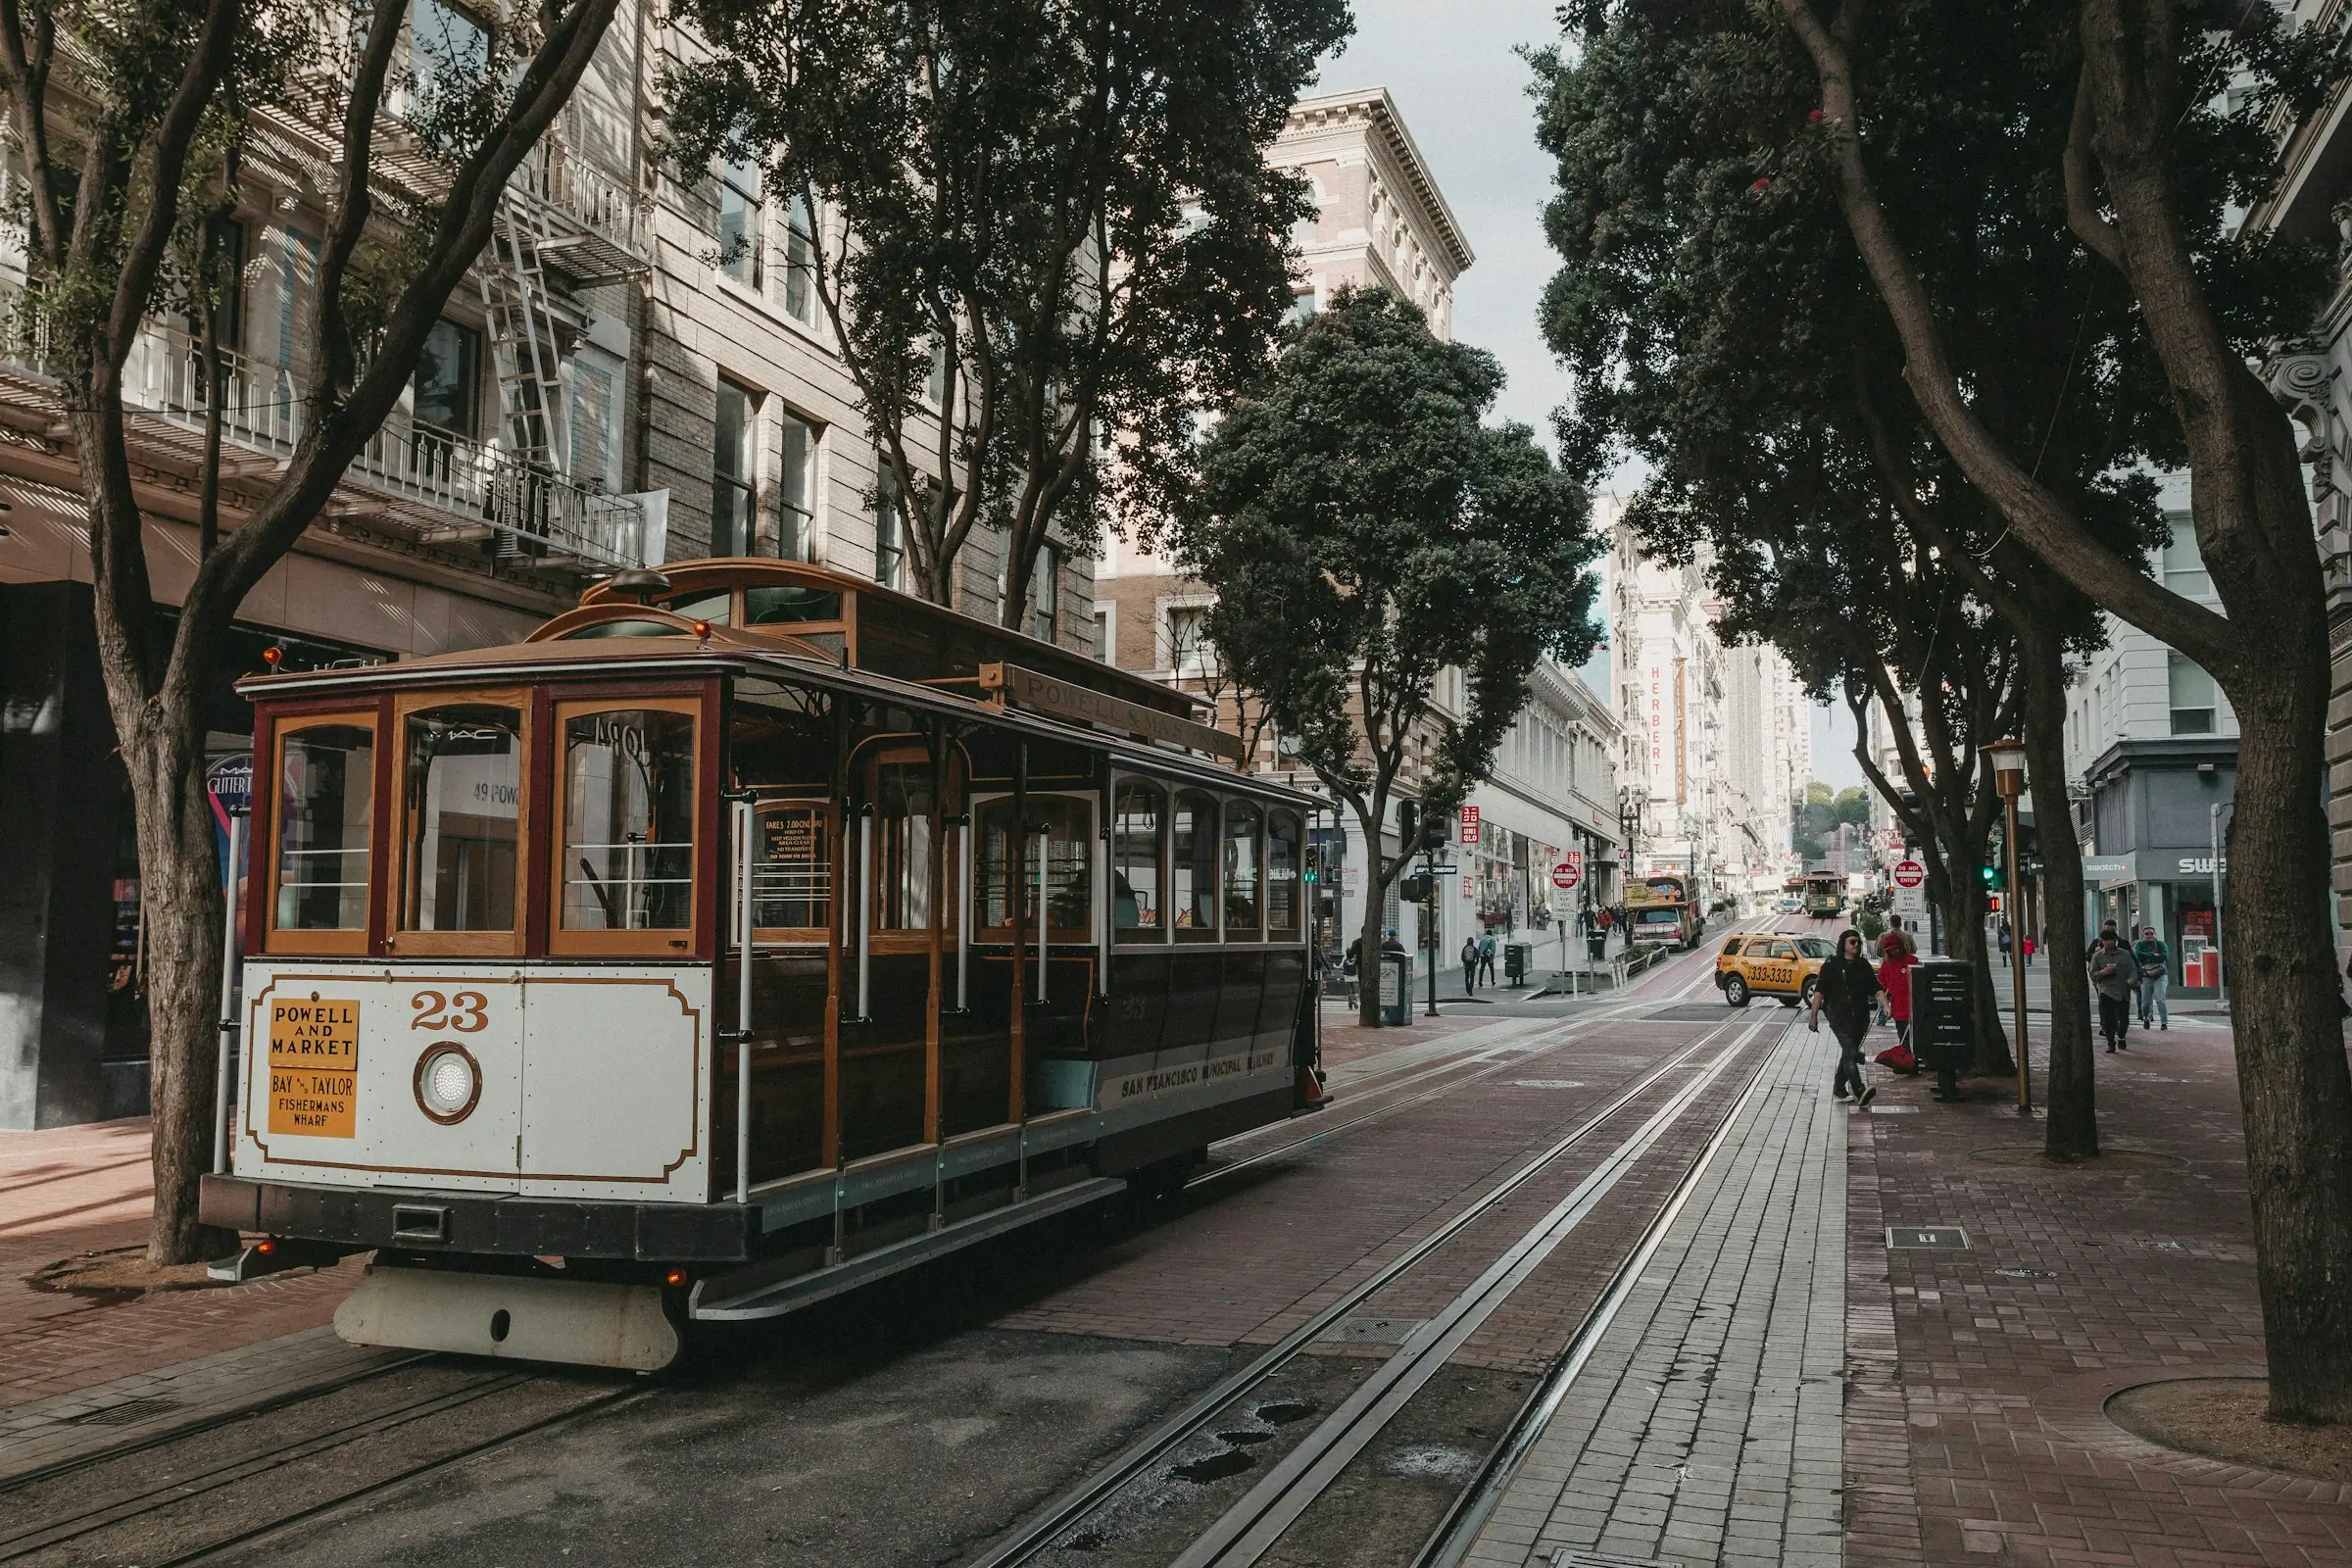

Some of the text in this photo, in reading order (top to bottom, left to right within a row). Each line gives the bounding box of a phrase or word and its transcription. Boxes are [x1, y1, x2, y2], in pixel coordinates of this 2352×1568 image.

[1027, 677, 1123, 722] POWELL
[1128, 712, 1140, 729] &
[1651, 667, 1660, 775] HERBERT
[208, 777, 245, 794] GLITTER
[491, 785, 519, 805] POW
[1751, 966, 1792, 983] 333-3333
[275, 1007, 353, 1023] POWELL
[412, 991, 488, 1032] 23
[295, 1025, 332, 1036] AND
[272, 1039, 353, 1054] MARKET
[272, 1075, 292, 1093] BAY
[312, 1077, 353, 1096] TAYLOR
[1121, 1080, 1143, 1098] SAN
[1147, 1067, 1198, 1092] FRANCISCO
[279, 1099, 344, 1113] FISHERMANS
[294, 1113, 327, 1126] WHARF
